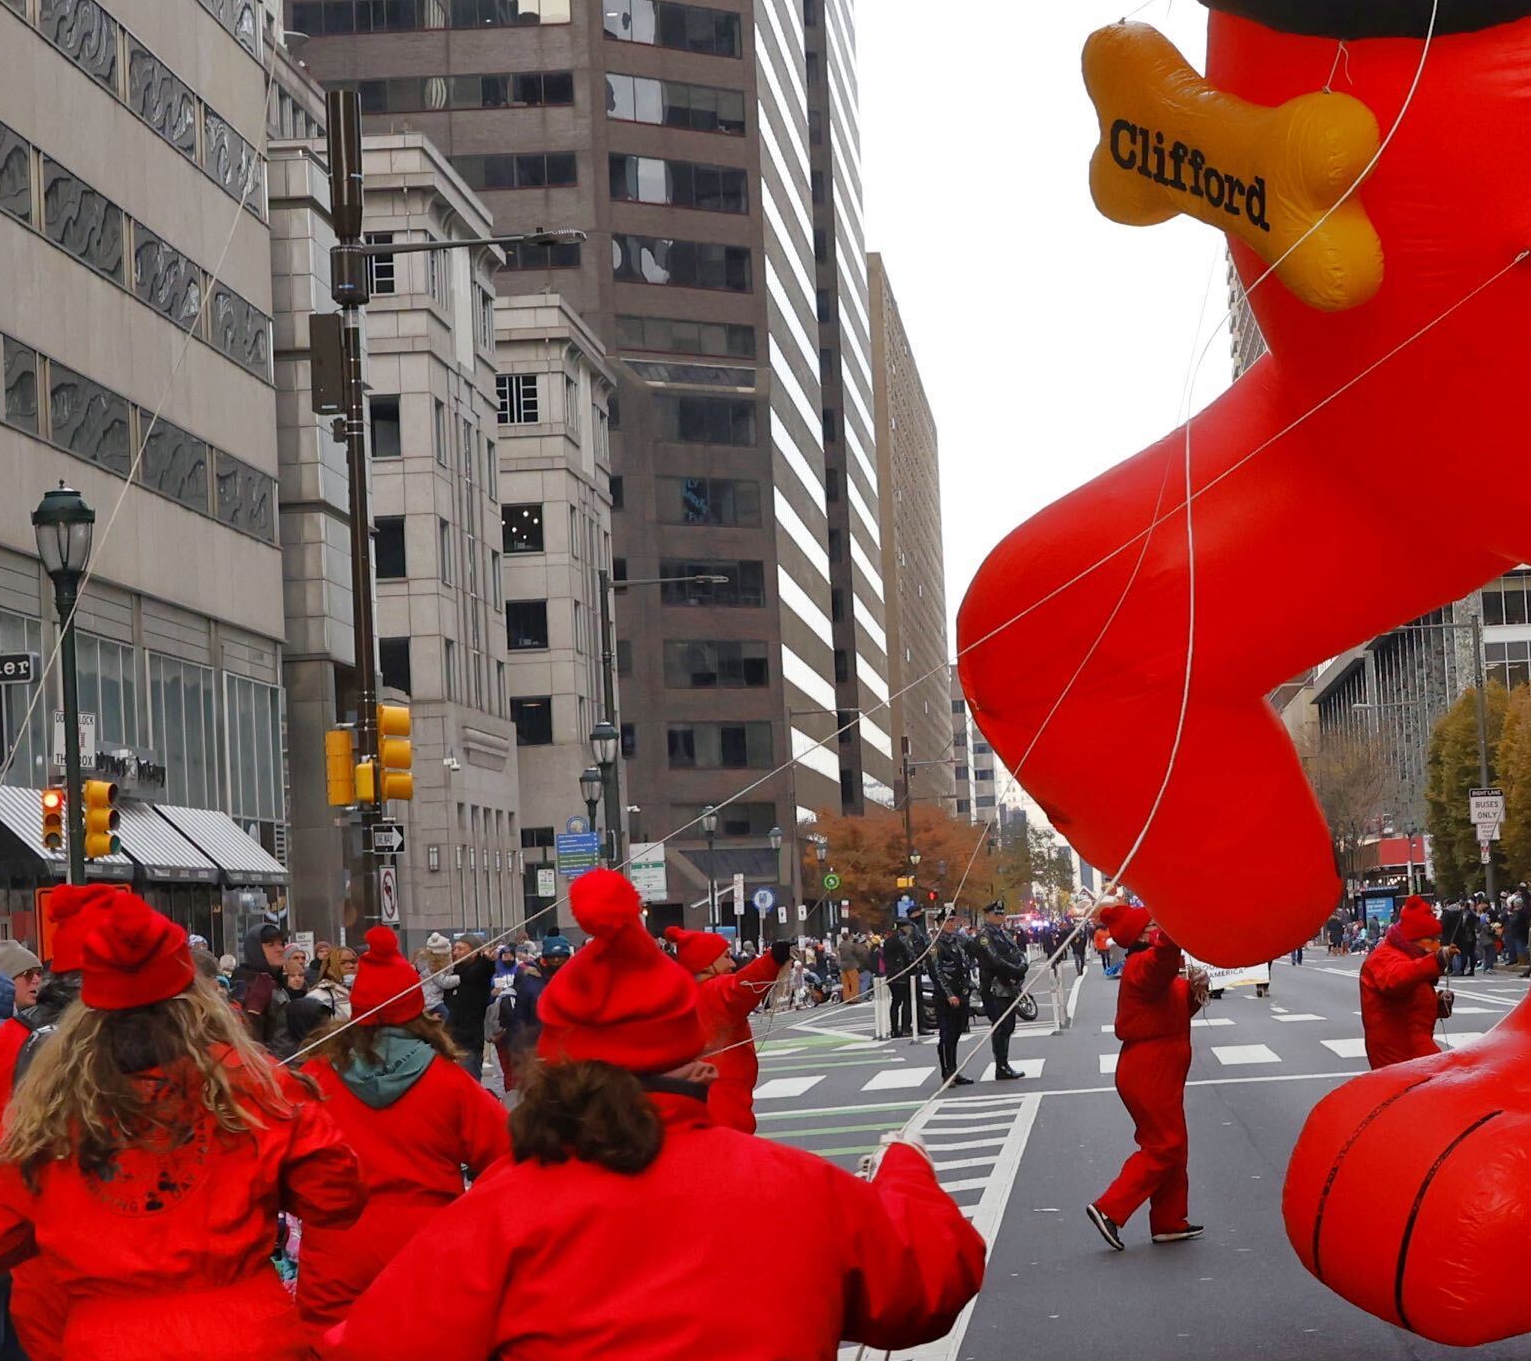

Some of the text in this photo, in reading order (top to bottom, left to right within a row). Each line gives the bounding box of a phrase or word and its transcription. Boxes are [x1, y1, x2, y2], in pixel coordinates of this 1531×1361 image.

[1110, 118, 1271, 232] Clifford
[78, 714, 94, 725] LOCK
[1475, 801, 1499, 809] BUSES
[1478, 811, 1498, 819] ONLY
